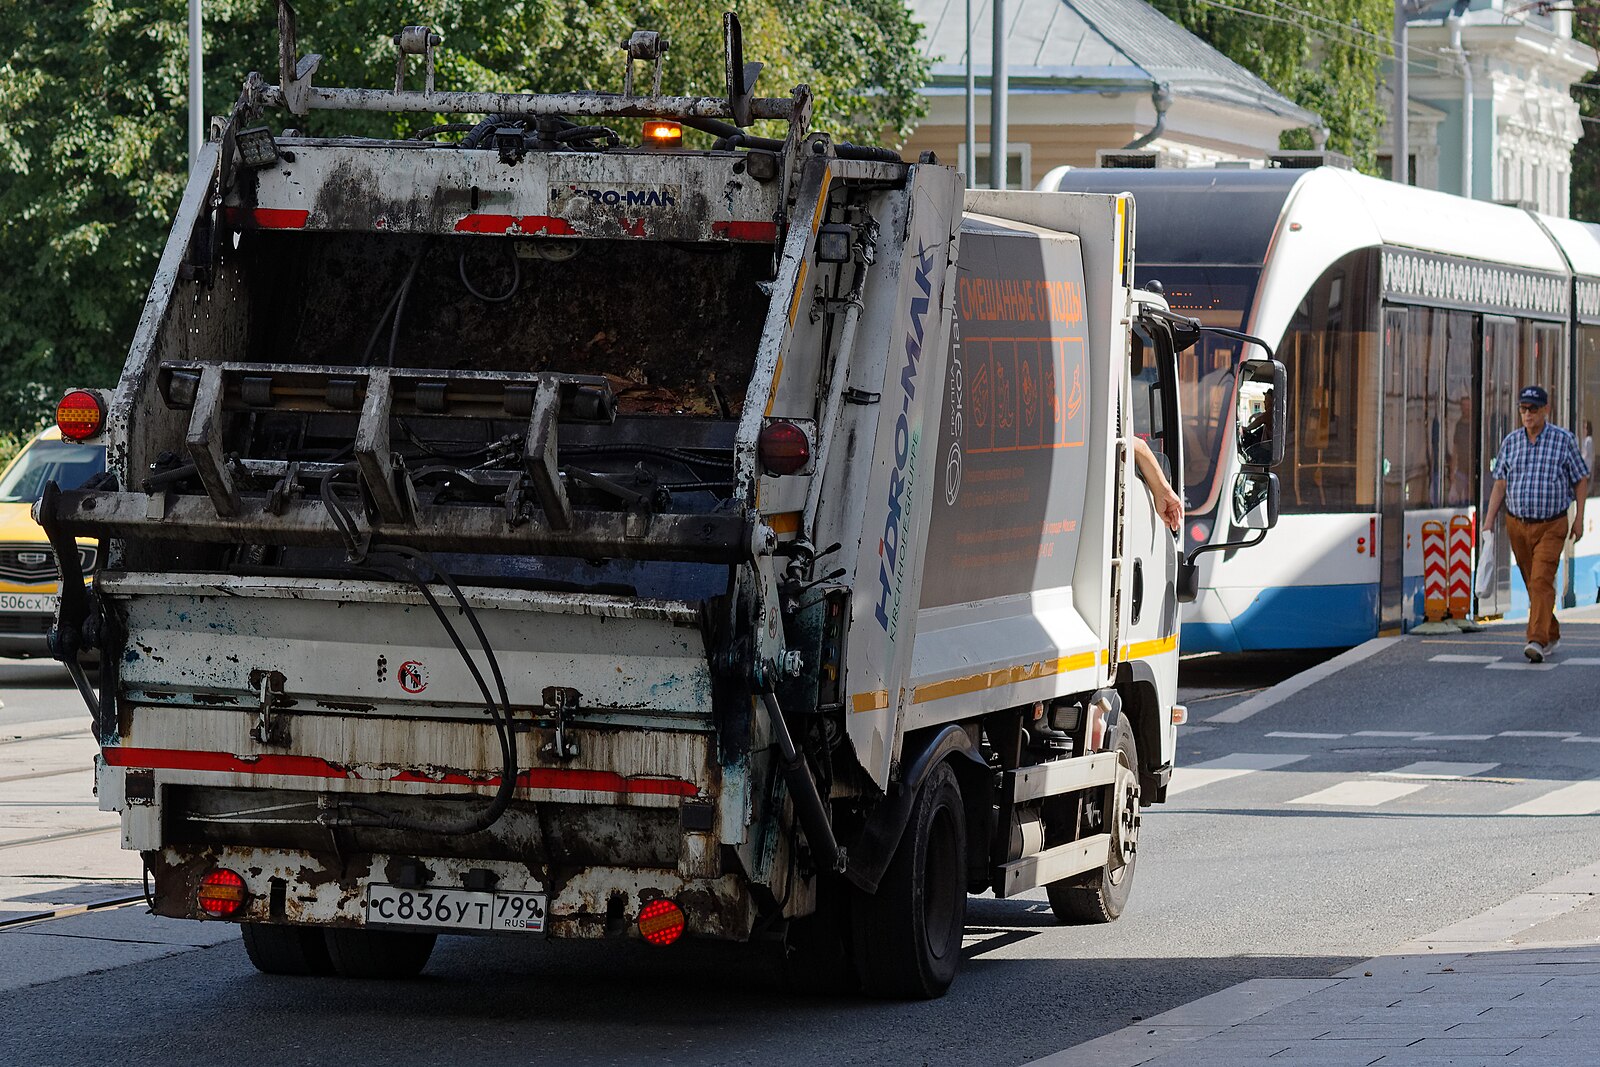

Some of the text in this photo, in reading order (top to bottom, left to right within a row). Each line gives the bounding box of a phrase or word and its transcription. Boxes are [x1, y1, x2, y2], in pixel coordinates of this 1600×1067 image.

[959, 276, 1083, 328] СМЕШАННЫЕ ОТХОДЫ
[496, 895, 539, 920] 799
[504, 918, 526, 929] RUS
